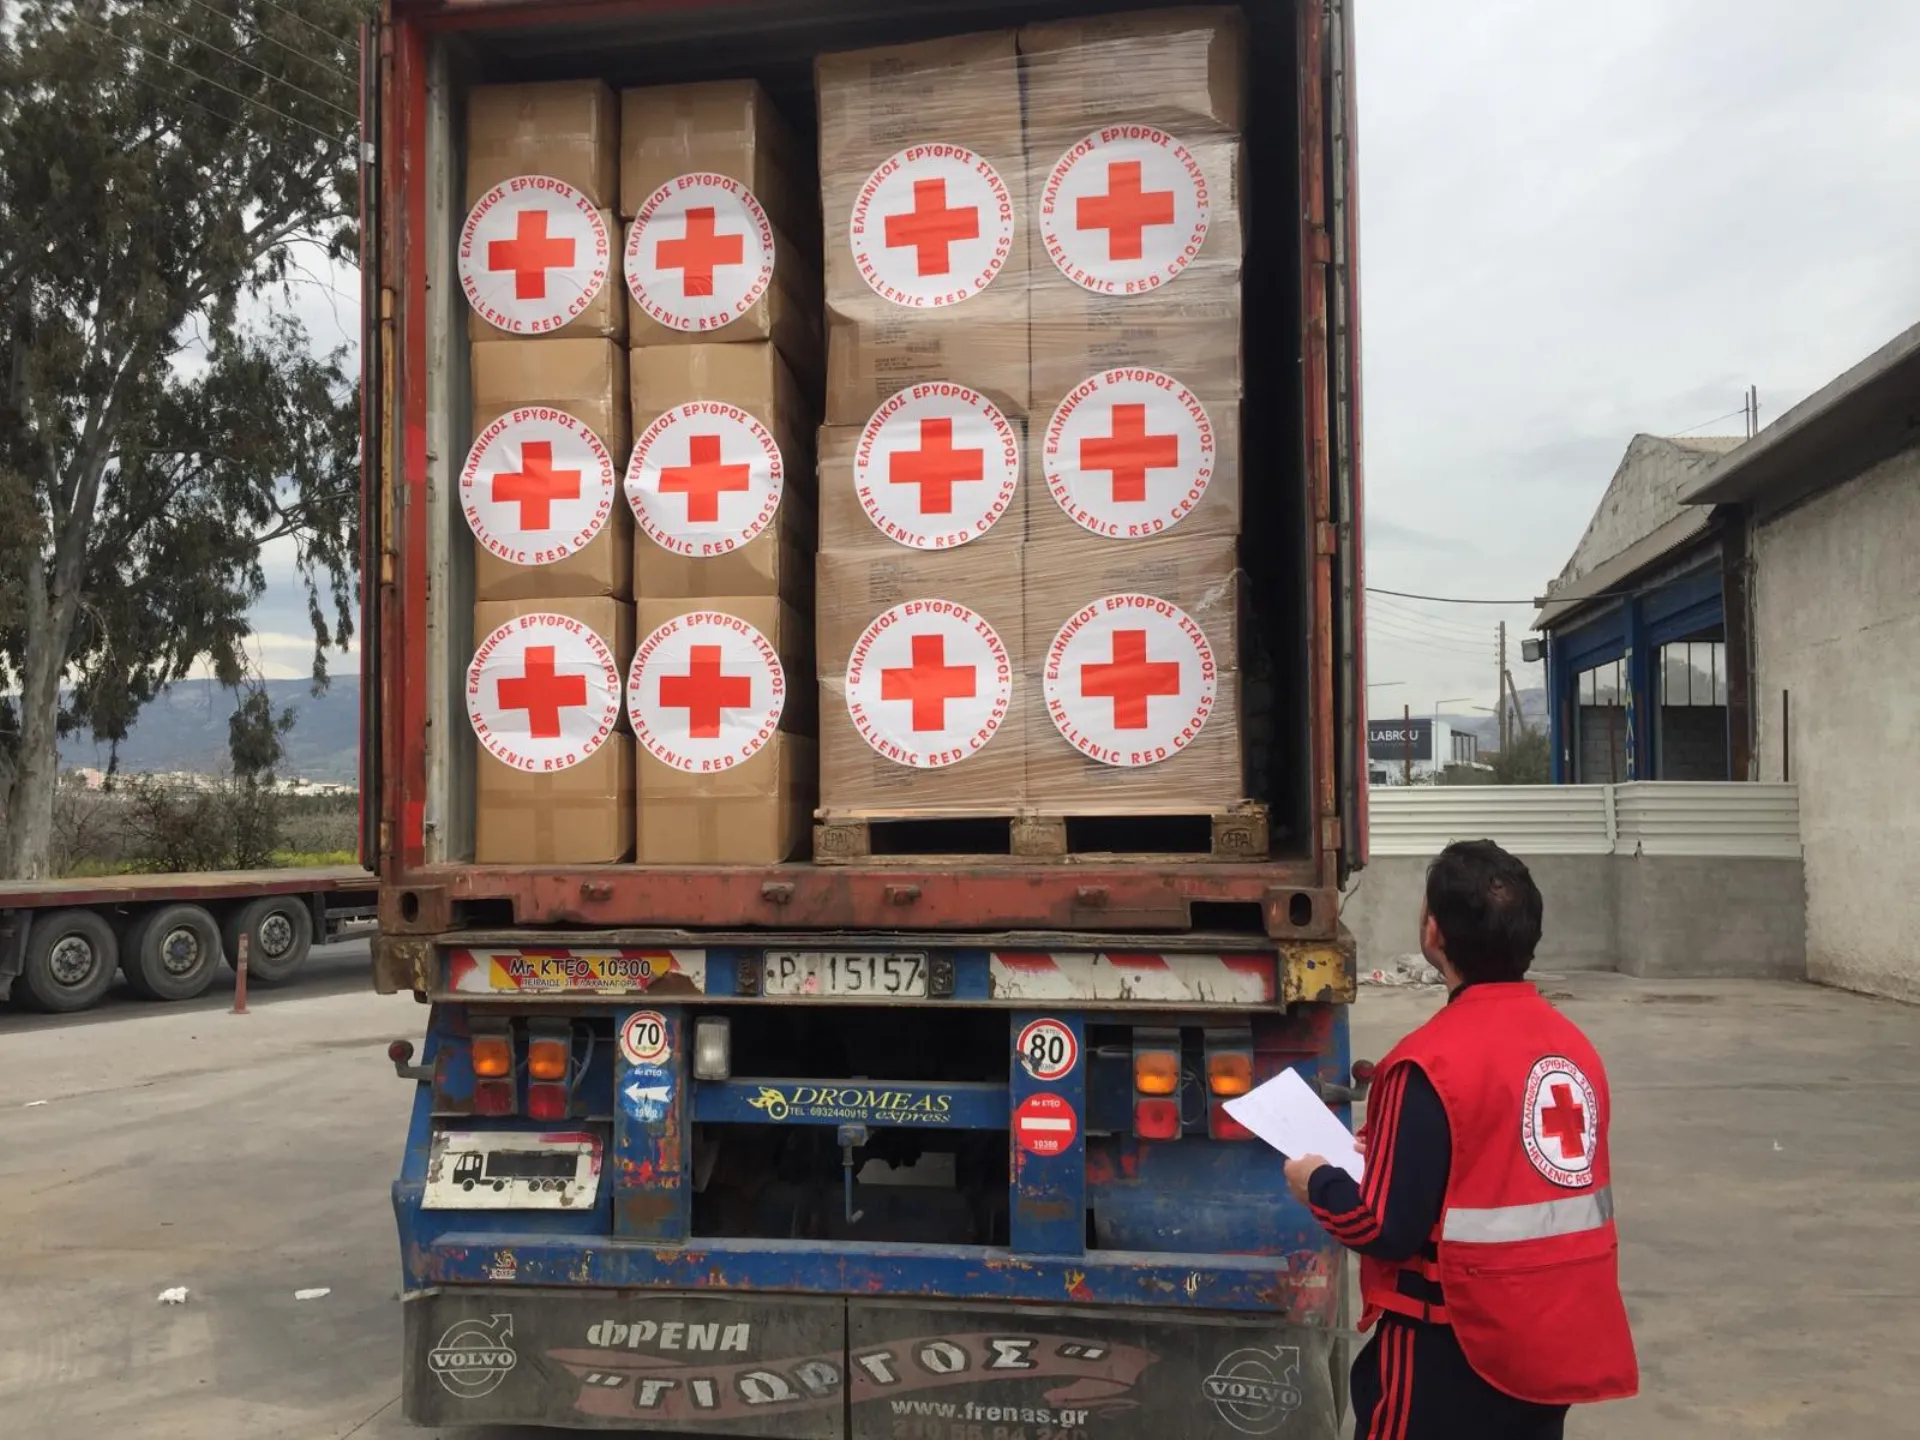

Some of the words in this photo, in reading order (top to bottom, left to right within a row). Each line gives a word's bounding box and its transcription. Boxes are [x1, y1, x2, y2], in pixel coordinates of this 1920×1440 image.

[853, 159, 900, 235] ΕΛΛΗΝΙΚΟΣ
[904, 146, 972, 164] ΕΡΥΘΡΟΣ
[976, 162, 1012, 222] ΣΤΑΥΡΟΣ
[1042, 137, 1093, 215] ΕΛΛΗΝΙΚΟΣ
[1100, 126, 1169, 146] ΕΡΥΘΡΟΣ
[1174, 147, 1208, 208] ΣΤΑΥΡΟΣ
[461, 188, 505, 259] ΕΛΛΗΝΙΚΟΣ
[509, 178, 574, 197] ΕΡΥΘΡΟΣ
[576, 197, 608, 256] ΣΤΑΥΡΟΣ
[627, 184, 671, 256] ΕΛΛΗΝΙΚΟΣ
[676, 175, 737, 192] ΕΡΥΘΡΟΣ
[743, 192, 773, 249] ΣΤΑΥΡΟΣ
[859, 253, 923, 305] HELLENIC
[934, 289, 966, 304] RED
[975, 237, 1011, 288] CROSS
[1047, 234, 1112, 289] HELLENIC
[1125, 275, 1161, 293] RED
[1168, 224, 1206, 277] CROSS
[464, 276, 522, 330] HELLENIC
[531, 314, 563, 332] RED
[568, 270, 606, 317] CROSS
[630, 273, 689, 328] HELLENIC
[698, 312, 729, 329] RED
[735, 265, 771, 312] CROSS
[631, 410, 676, 480] ΕΛΛΗΝΙΚΟΣ
[681, 403, 747, 423] ΕΡΥΘΡΟΣ
[751, 423, 782, 479] ΣΤΑΥΡΟΣ
[857, 394, 905, 470] ΕΛΛΗΝΙΚΟΣ
[912, 384, 978, 405] ΕΡΥΘΡΟΣ
[983, 405, 1017, 465] ΣΤΑΥΡΟΣ
[1047, 379, 1097, 455] ΕΛΛΗΝΙΚΟΣ
[1104, 369, 1174, 390] ΕΡΥΘΡΟΣ
[1178, 390, 1213, 452] ΣΤΑΥΡΟΣ
[462, 418, 508, 489] ΕΛΛΗΝΙΚΟΣ
[511, 409, 577, 429] ΕΡΥΘΡΟΣ
[580, 427, 613, 487] ΣΤΑΥΡΟΣ
[466, 505, 524, 562] HELLENIC
[534, 545, 569, 563] RED
[572, 501, 611, 549] CROSS
[631, 496, 692, 554] HELLENIC
[702, 537, 735, 556] RED
[743, 493, 779, 540] CROSS
[860, 486, 923, 544] HELLENIC
[936, 531, 968, 548] RED
[975, 482, 1015, 533] CROSS
[1049, 473, 1117, 535] HELLENIC
[1127, 519, 1163, 536] RED
[1171, 469, 1211, 518] CROSS
[469, 625, 514, 696] ΕΛΛΗΝΙΚΟΣ
[520, 615, 582, 634] ΕΡΥΘΡΟΣ
[588, 632, 619, 691] ΣΤΑΥΡΟΣ
[629, 621, 677, 691] ΕΛΛΗΝΙΚΟΣ
[685, 614, 748, 634] ΕΡΥΘΡΟΣ
[753, 635, 784, 696] ΣΤΑΥΡΟΣ
[849, 612, 897, 685] ΕΛΛΗΝΙΚΟΣ
[904, 601, 973, 621] ΕΡΥΘΡΟΣ
[975, 620, 1010, 682] ΣΤΑΥΡΟΣ
[1046, 605, 1096, 680] ΕΛΛΗΝΙΚΟΣ
[1104, 596, 1176, 618] ΕΡΥΘΡΟΣ
[1177, 616, 1215, 681] ΣΤΑΥΡΟΣ
[472, 713, 534, 770] HELLENIC
[542, 753, 576, 770] RED
[582, 706, 617, 754] CROSS
[631, 710, 692, 769] HELLENIC
[701, 754, 734, 771] RED
[741, 710, 781, 760] CROSS
[852, 704, 917, 765] HELLENIC
[928, 748, 962, 766] RED
[970, 698, 1008, 751] CROSS
[1049, 699, 1119, 764] HELLENIC
[1130, 747, 1167, 765] RED
[1172, 696, 1213, 749] CROSS
[510, 959, 535, 977] Mr
[598, 959, 651, 977] 10300
[635, 1023, 660, 1046] 70
[1030, 1034, 1064, 1064] 80
[792, 1086, 952, 1112] DROMEAS
[876, 1109, 951, 1124] express
[1528, 1145, 1574, 1185] HELLENIC
[433, 1351, 513, 1367] VOLVO
[1208, 1380, 1299, 1404] VOLVO
[890, 1400, 1089, 1428] www.frenas.gr
